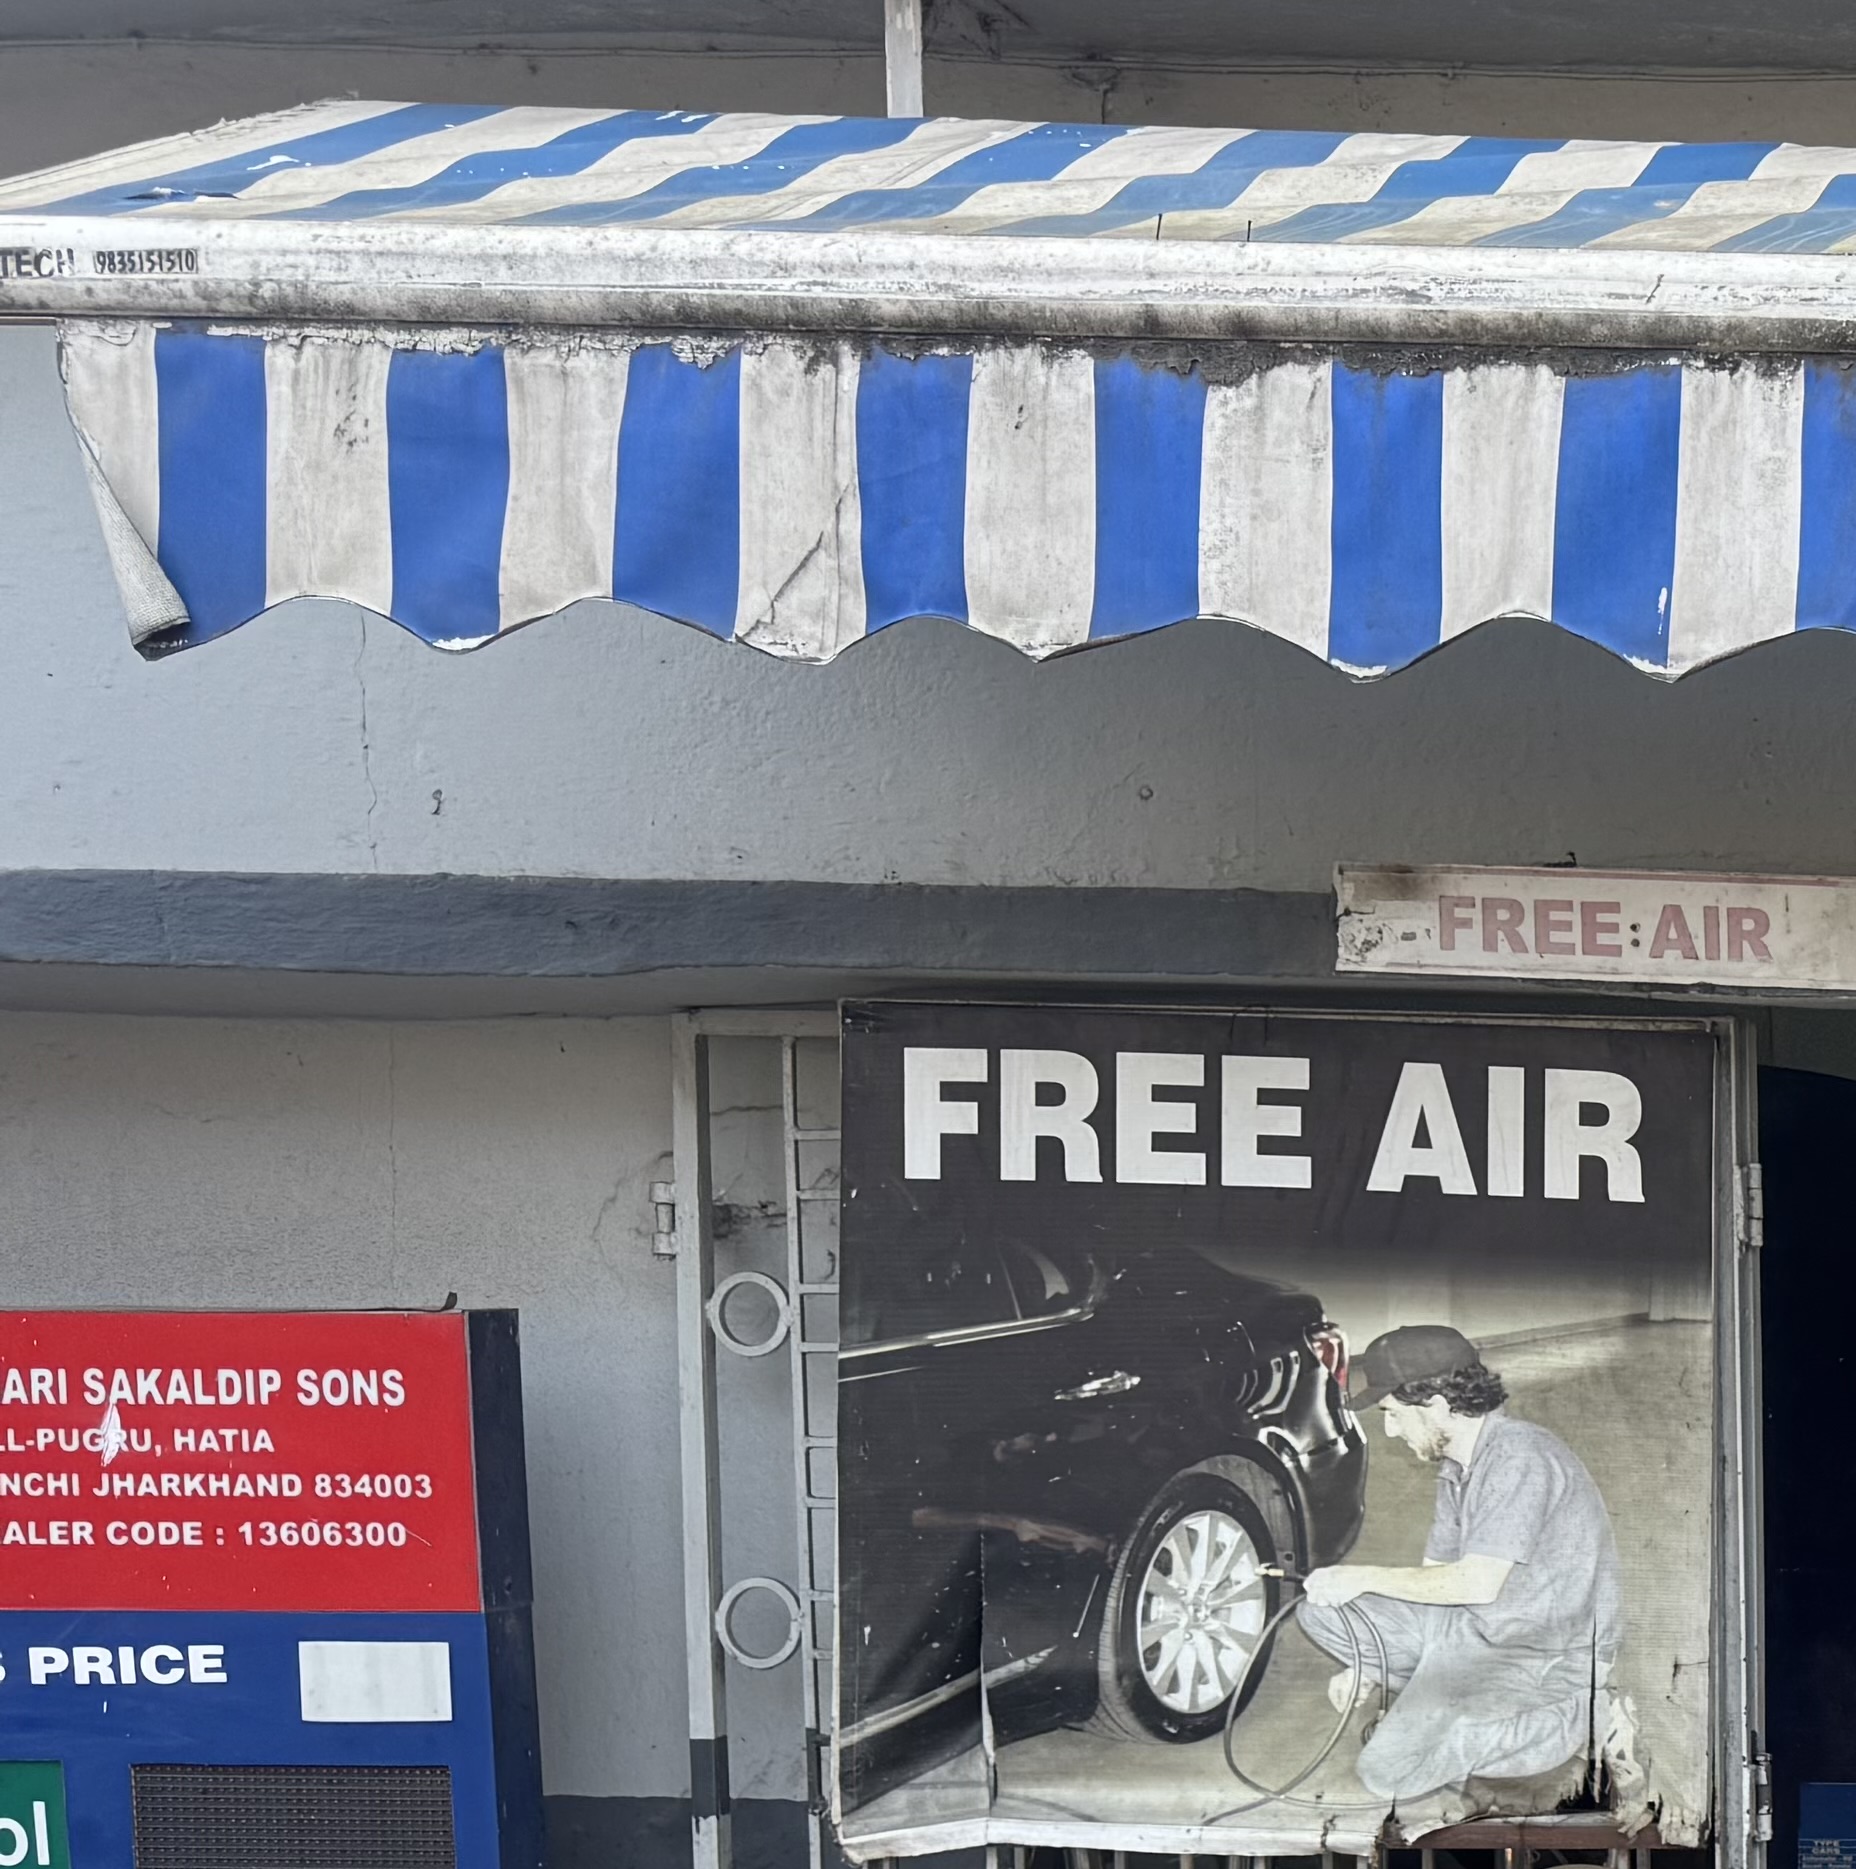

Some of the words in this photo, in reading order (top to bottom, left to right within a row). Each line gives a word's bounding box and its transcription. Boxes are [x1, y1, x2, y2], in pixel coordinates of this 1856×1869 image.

[1438, 894, 1623, 958] FREE
[1648, 904, 1774, 960] AIR
[903, 1046, 1313, 1189] FREE
[1366, 1062, 1646, 1203] AIR
[3, 1368, 67, 1405] ARI
[83, 1368, 281, 1406] SAKALDIP
[297, 1369, 406, 1407] SONS
[0, 1428, 162, 1457] L-PUGRU,
[174, 1428, 275, 1453] HATIA
[0, 1472, 80, 1497] NCHI
[92, 1472, 302, 1498] JHARKHAND
[314, 1474, 433, 1498] 834003
[2, 1520, 95, 1546] ALER
[106, 1520, 204, 1546] CODE
[238, 1521, 407, 1547] 13606300
[28, 1644, 228, 1685] PRICE
